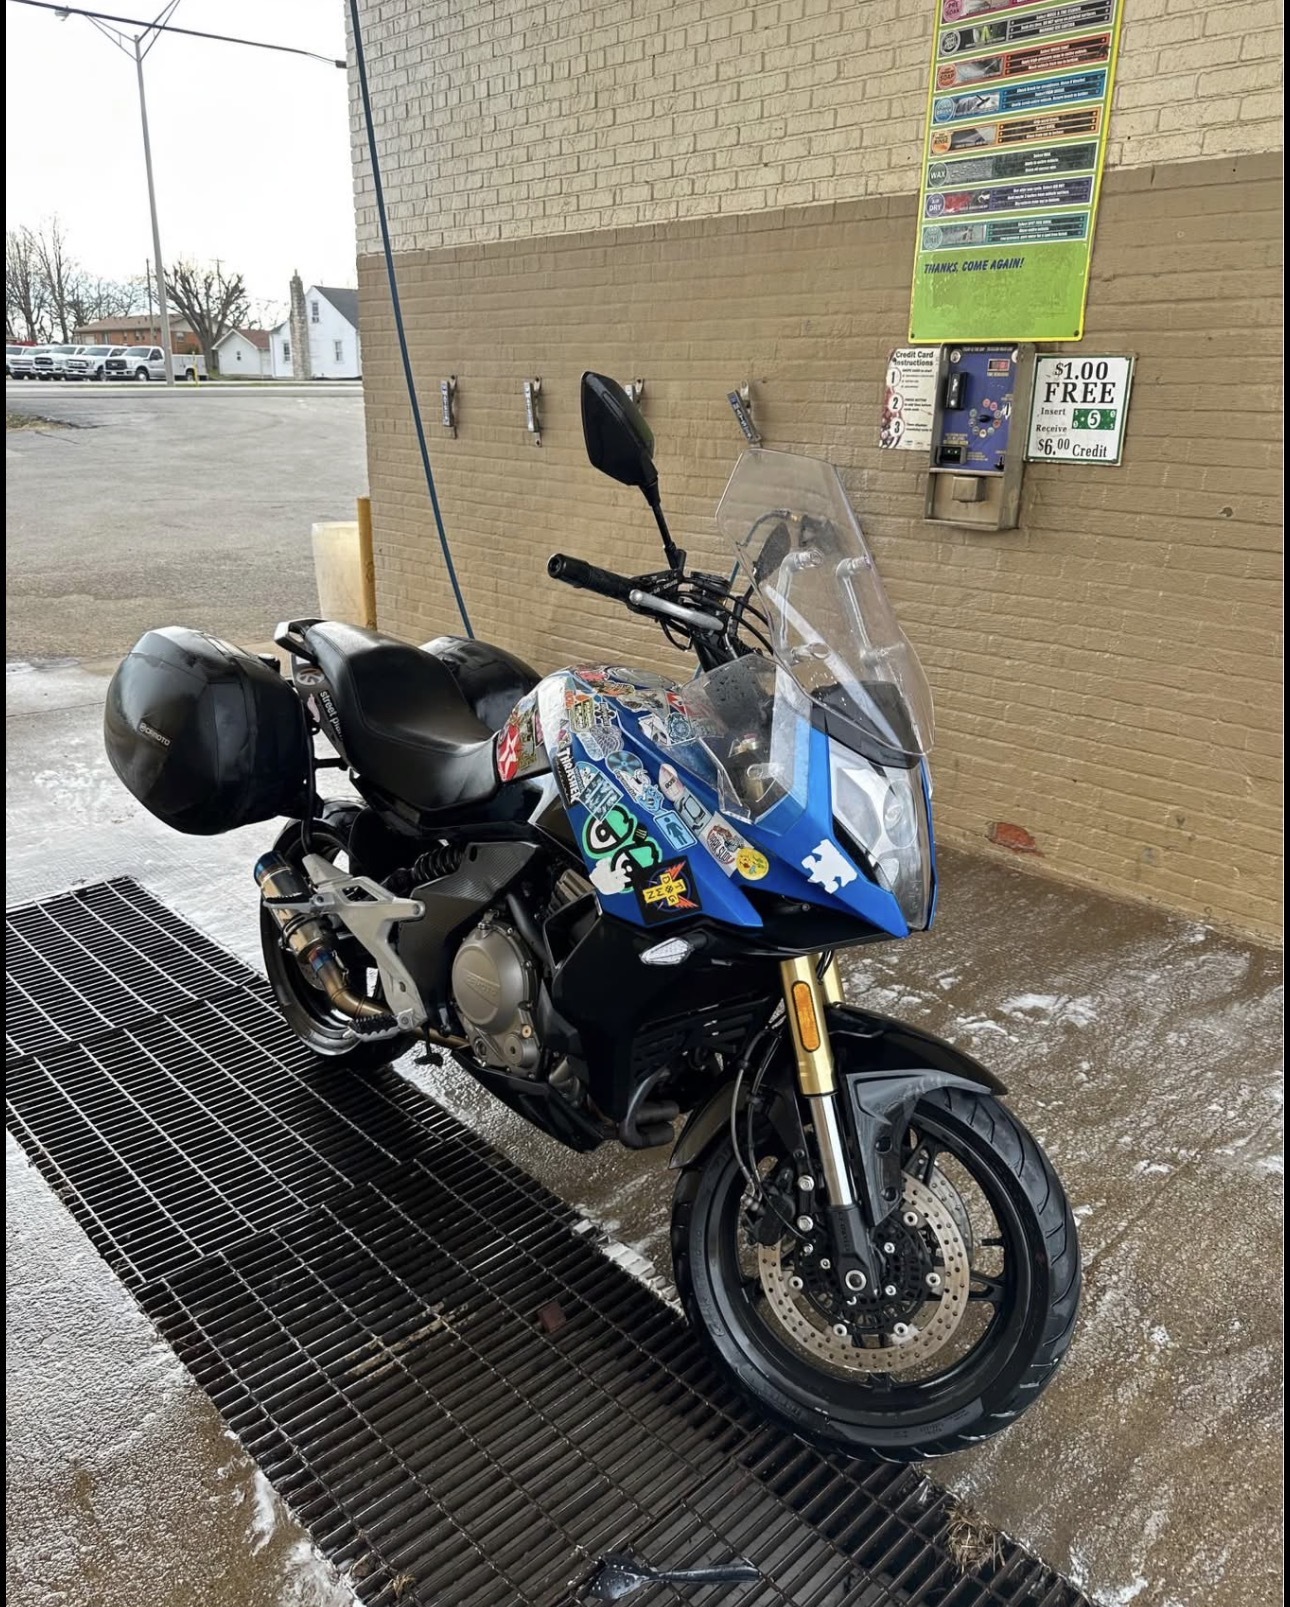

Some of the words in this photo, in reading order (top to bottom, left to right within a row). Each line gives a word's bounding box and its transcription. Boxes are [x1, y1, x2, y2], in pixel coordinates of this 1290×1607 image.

[930, 171, 945, 179] WAX
[929, 203, 942, 212] DRY
[962, 260, 989, 271] COME
[990, 257, 1025, 270] AGAIN!
[891, 371, 896, 384] 1
[1054, 361, 1109, 380] $1.00
[1043, 381, 1116, 404] FREE
[892, 396, 899, 410] 2
[1041, 407, 1066, 416] Insert
[1089, 412, 1098, 426] 5
[894, 421, 900, 434] 3
[1036, 424, 1067, 433] Receive
[1037, 438, 1070, 456] $6.00
[1072, 444, 1107, 458] Credit
[319, 690, 337, 717] street
[557, 747, 581, 804] THRASHER
